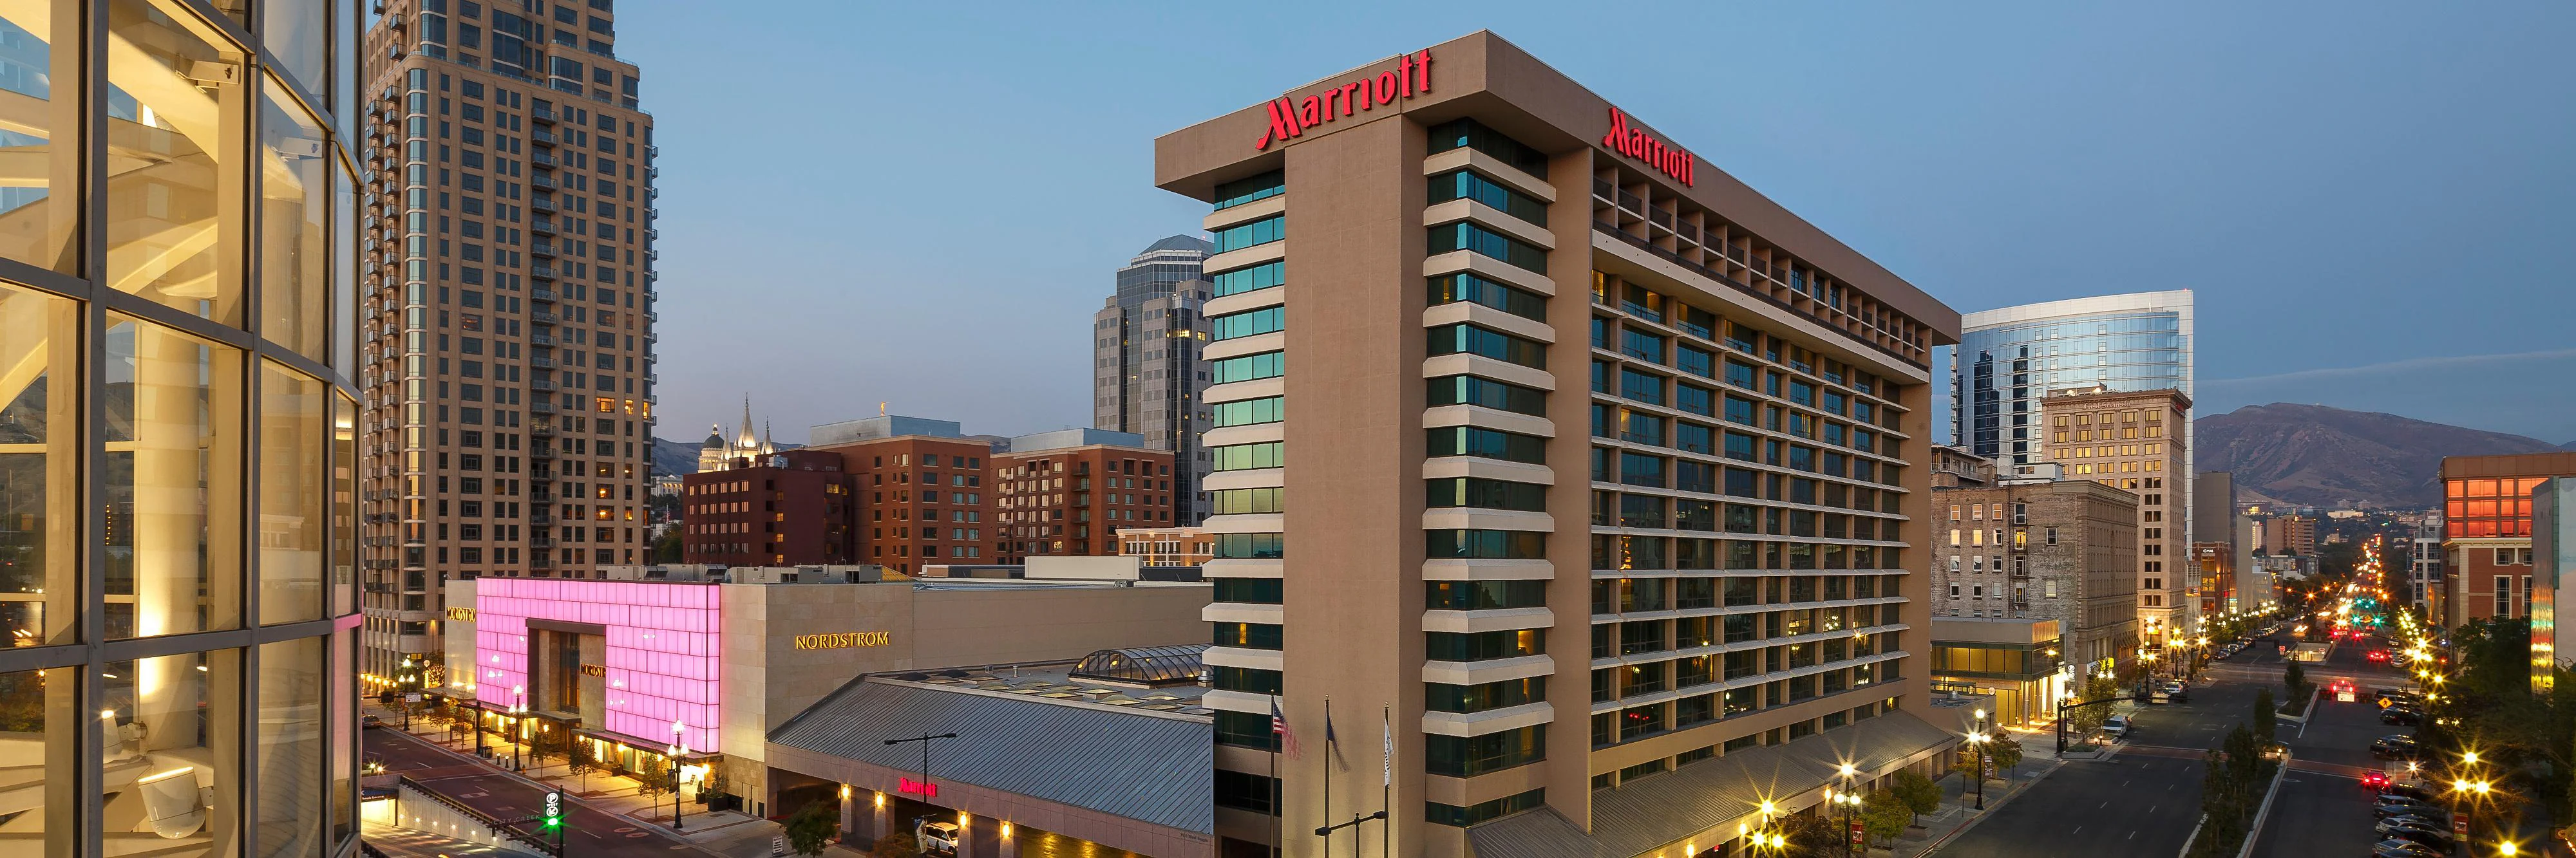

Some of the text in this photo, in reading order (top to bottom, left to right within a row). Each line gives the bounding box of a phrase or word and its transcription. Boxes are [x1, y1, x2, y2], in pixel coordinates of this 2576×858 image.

[1255, 48, 1432, 151] Marriott
[1602, 106, 1694, 188] Marriott
[446, 606, 476, 622] NORDSTRO
[796, 631, 889, 649] NORDSTROM
[580, 663, 606, 678] NORDSTR
